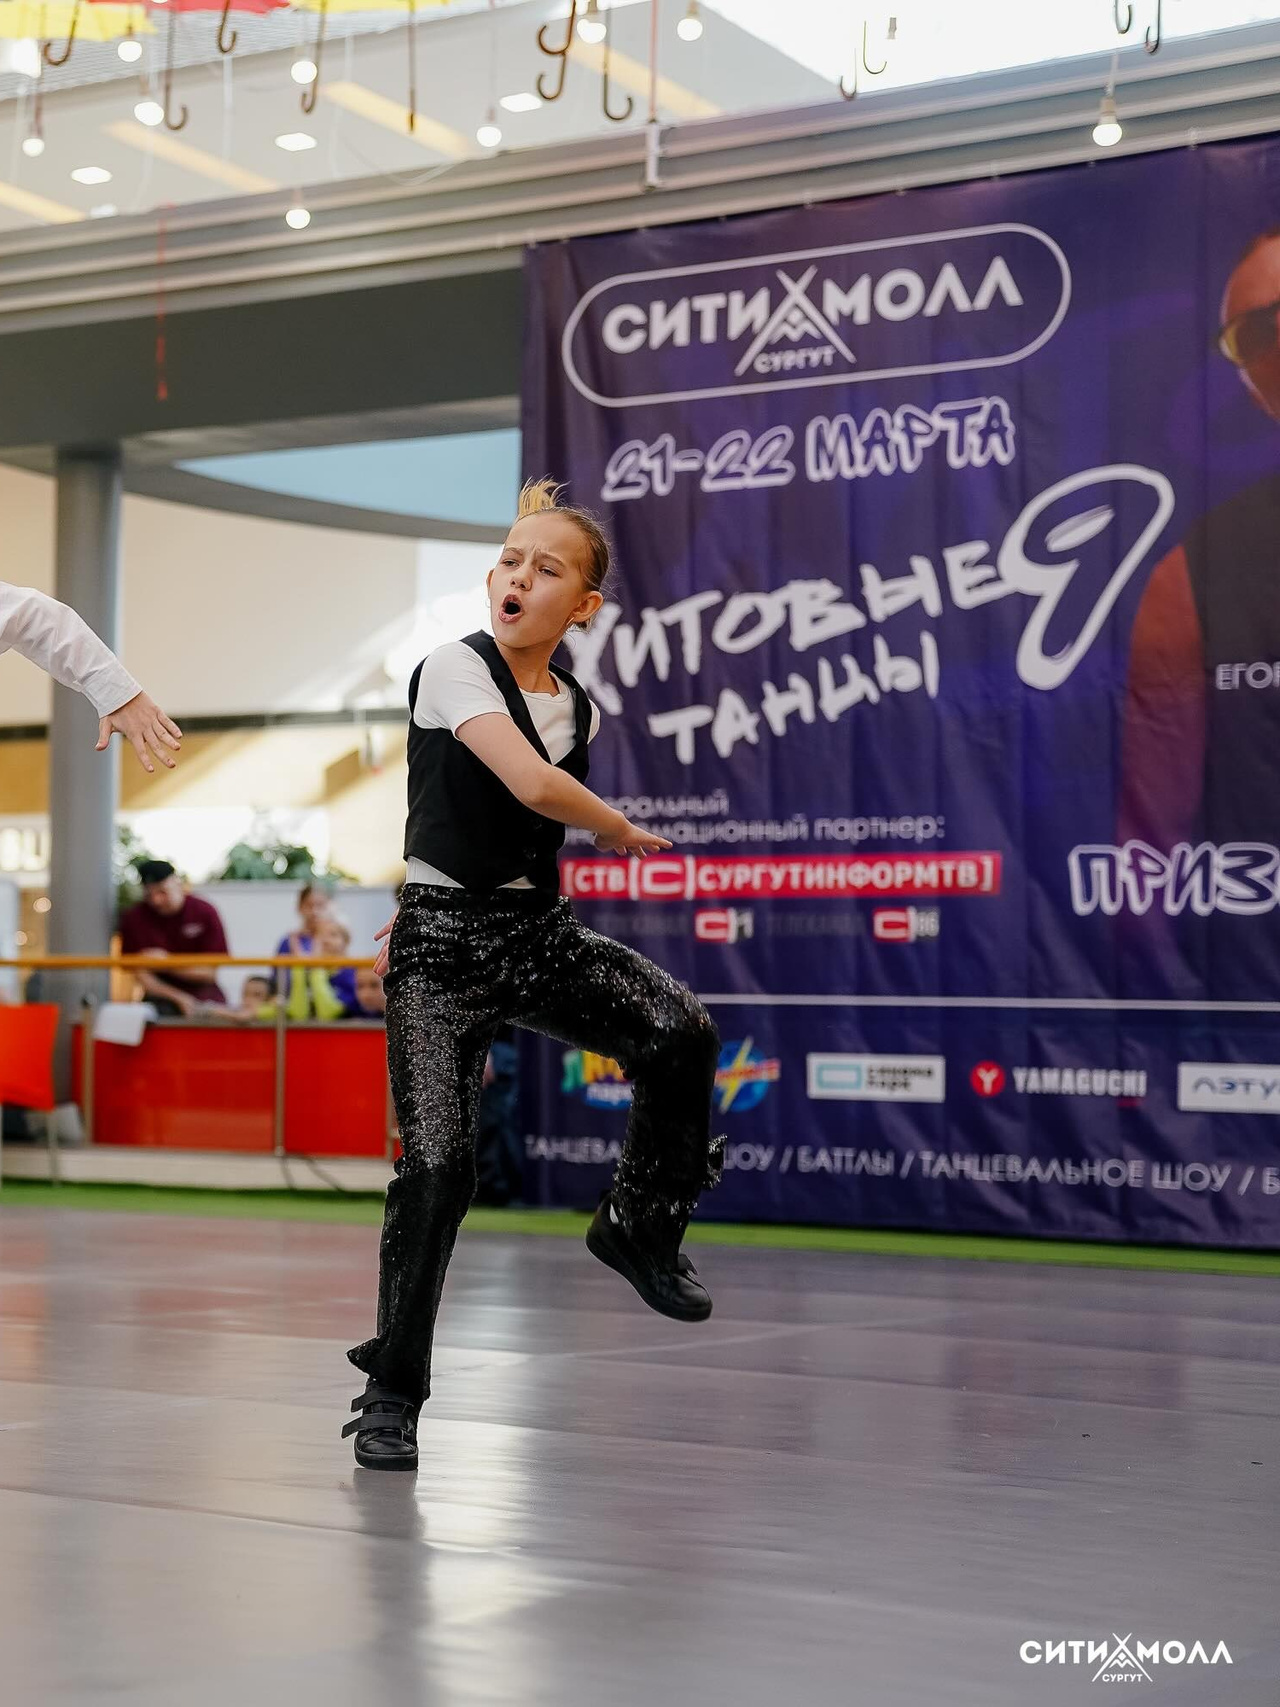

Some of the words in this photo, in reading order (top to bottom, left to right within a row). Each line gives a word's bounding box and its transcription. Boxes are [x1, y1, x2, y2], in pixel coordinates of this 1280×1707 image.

[822, 254, 1024, 326] МОЛЛ
[753, 344, 837, 375] СУРГУТ
[601, 425, 796, 502] 21-22
[805, 395, 1016, 482] МАРТА
[647, 630, 940, 766] ТАНЦЫ
[1012, 1066, 1148, 1097] YAMAGUCHI
[1193, 1076, 1280, 1100] ЛЭТУ
[796, 1145, 895, 1176] БАТТЛЫ
[920, 1150, 1145, 1188] ТАНЦЕВАЛЬНОЕ
[1151, 1161, 1232, 1193] ШОУ
